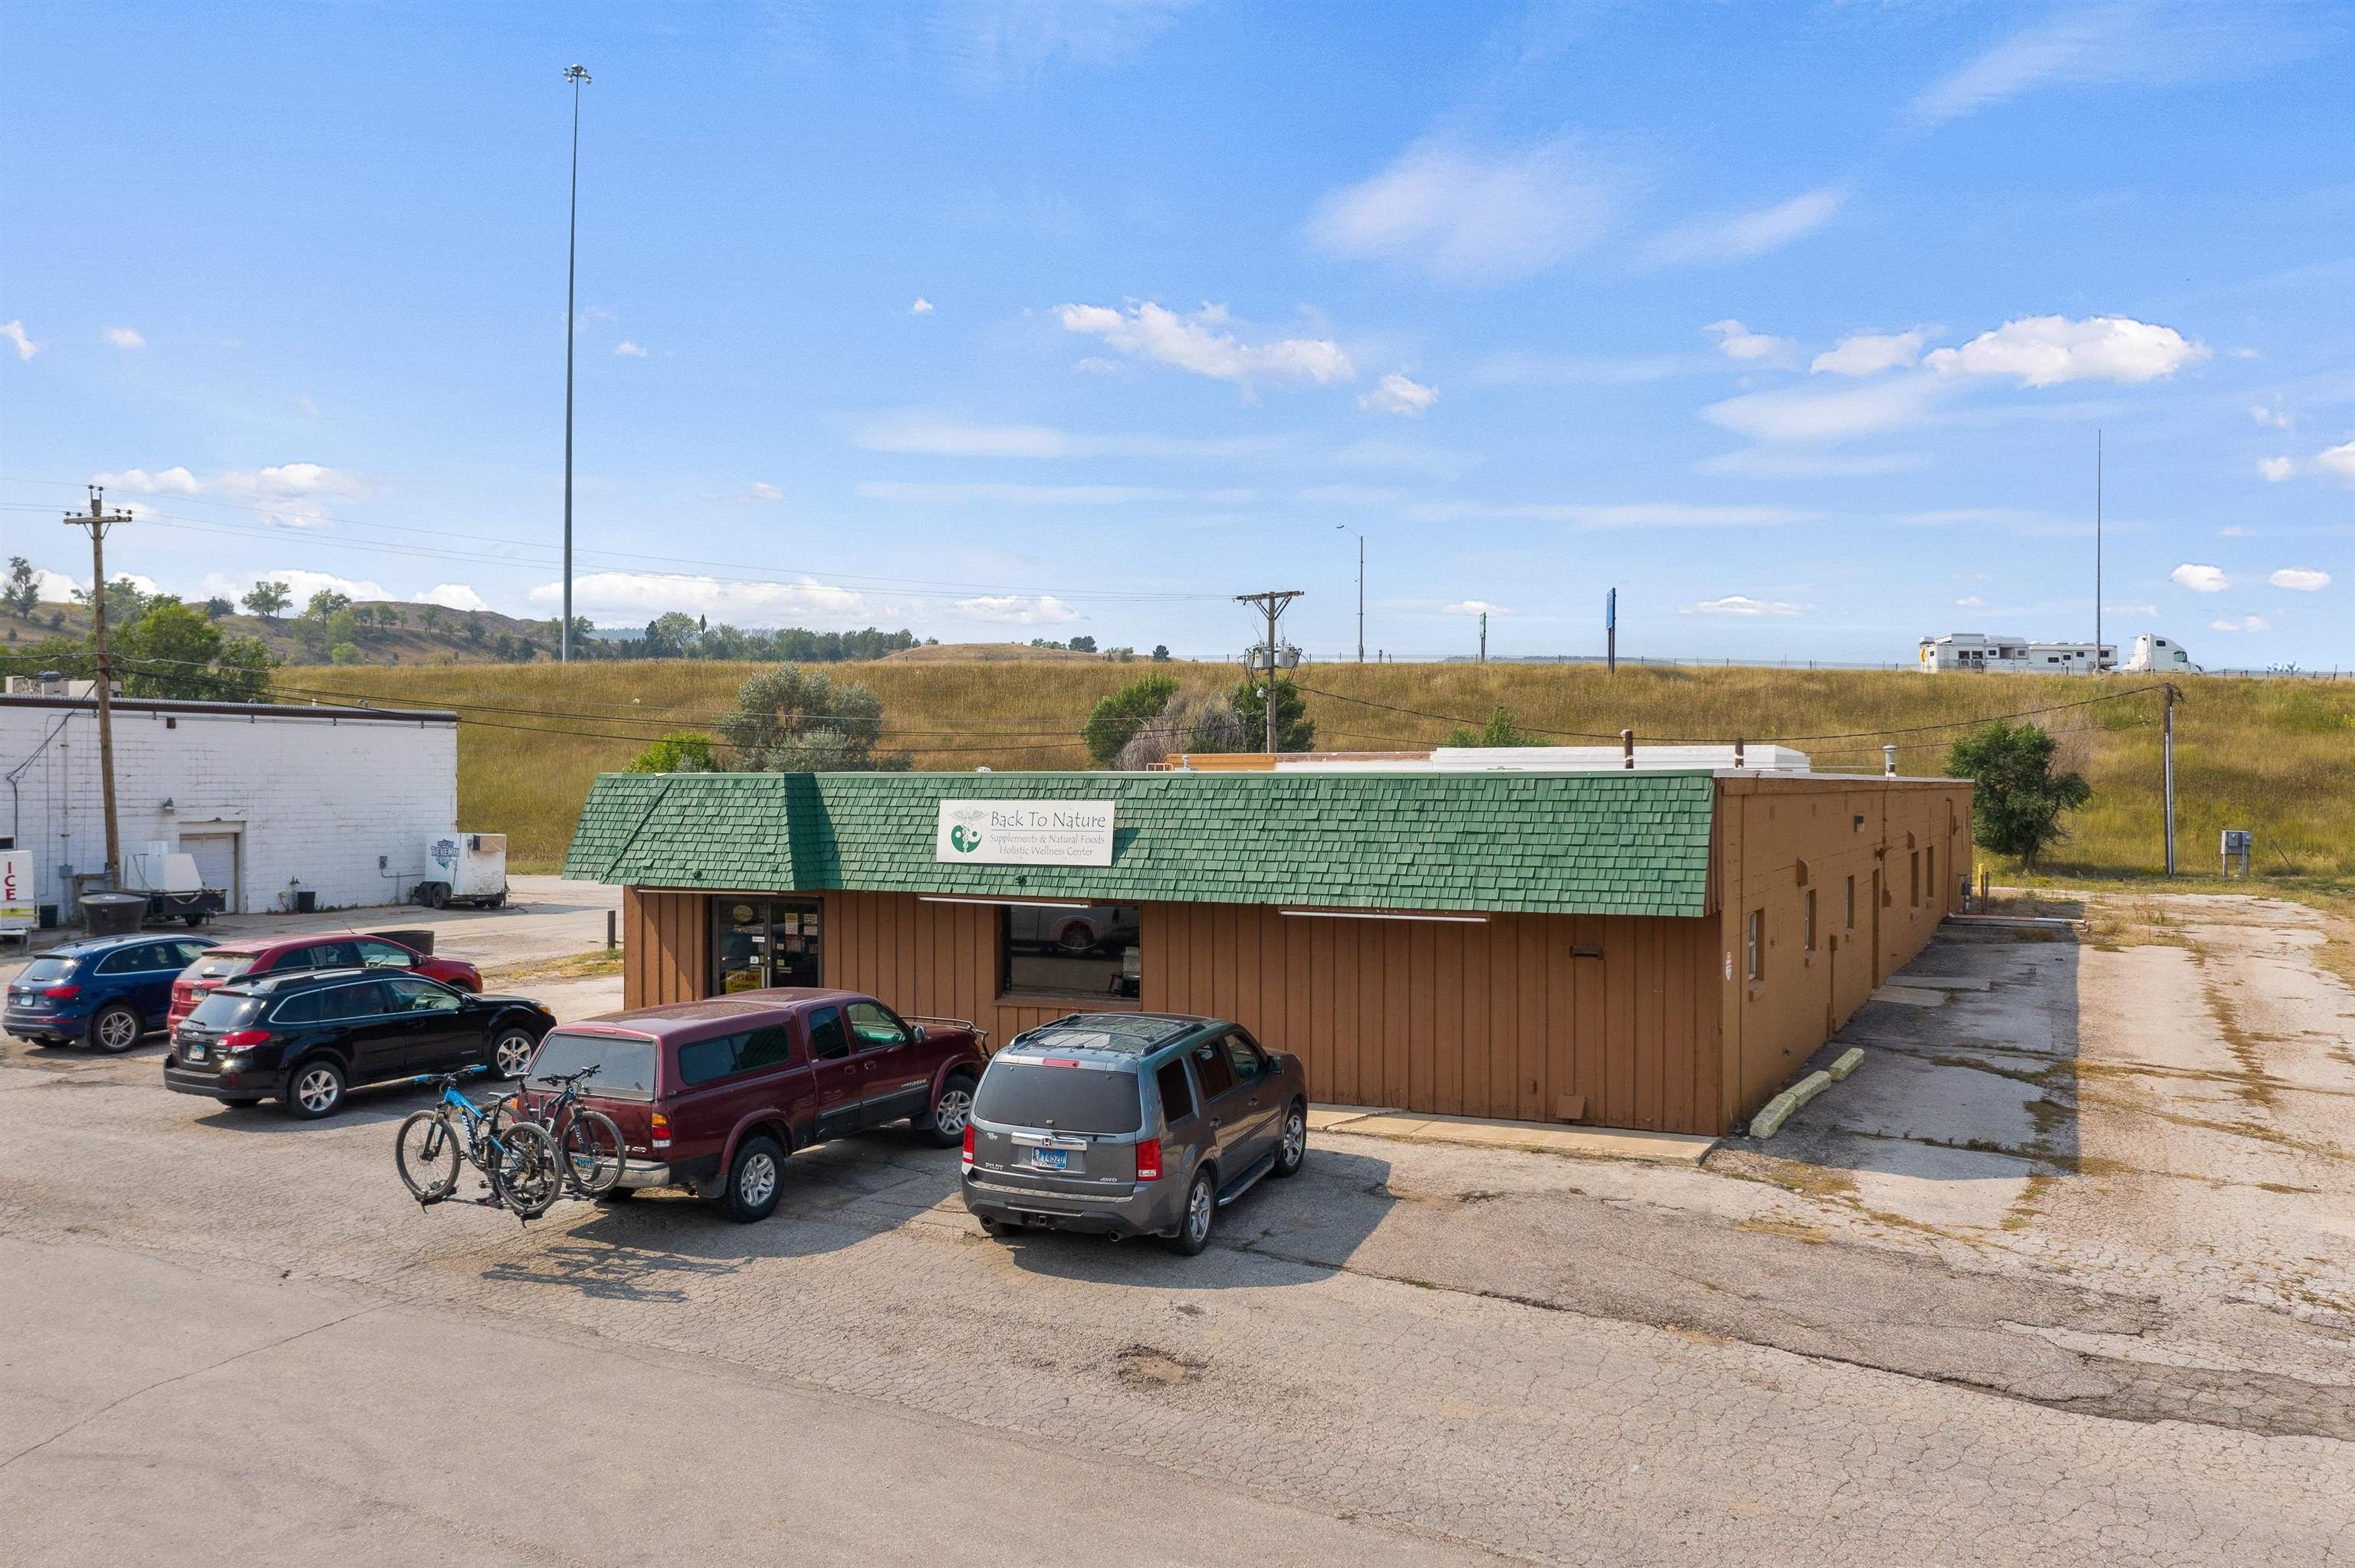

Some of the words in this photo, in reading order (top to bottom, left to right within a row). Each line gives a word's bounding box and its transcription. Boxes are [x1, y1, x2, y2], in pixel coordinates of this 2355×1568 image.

[991, 810, 1023, 828] Back
[1029, 812, 1047, 827] To
[1053, 812, 1105, 828] Nature
[990, 833, 1037, 845] Supplements
[1040, 835, 1046, 844] &
[1049, 834, 1078, 844] Natural
[1080, 835, 1105, 845] Foods
[1000, 845, 1030, 855] Holistic
[1031, 845, 1065, 855] Wellness
[1066, 846, 1093, 856] Center
[4, 861, 17, 901] ICE
[461, 1115, 474, 1144] GIANT
[985, 1163, 1004, 1171] PILOT
